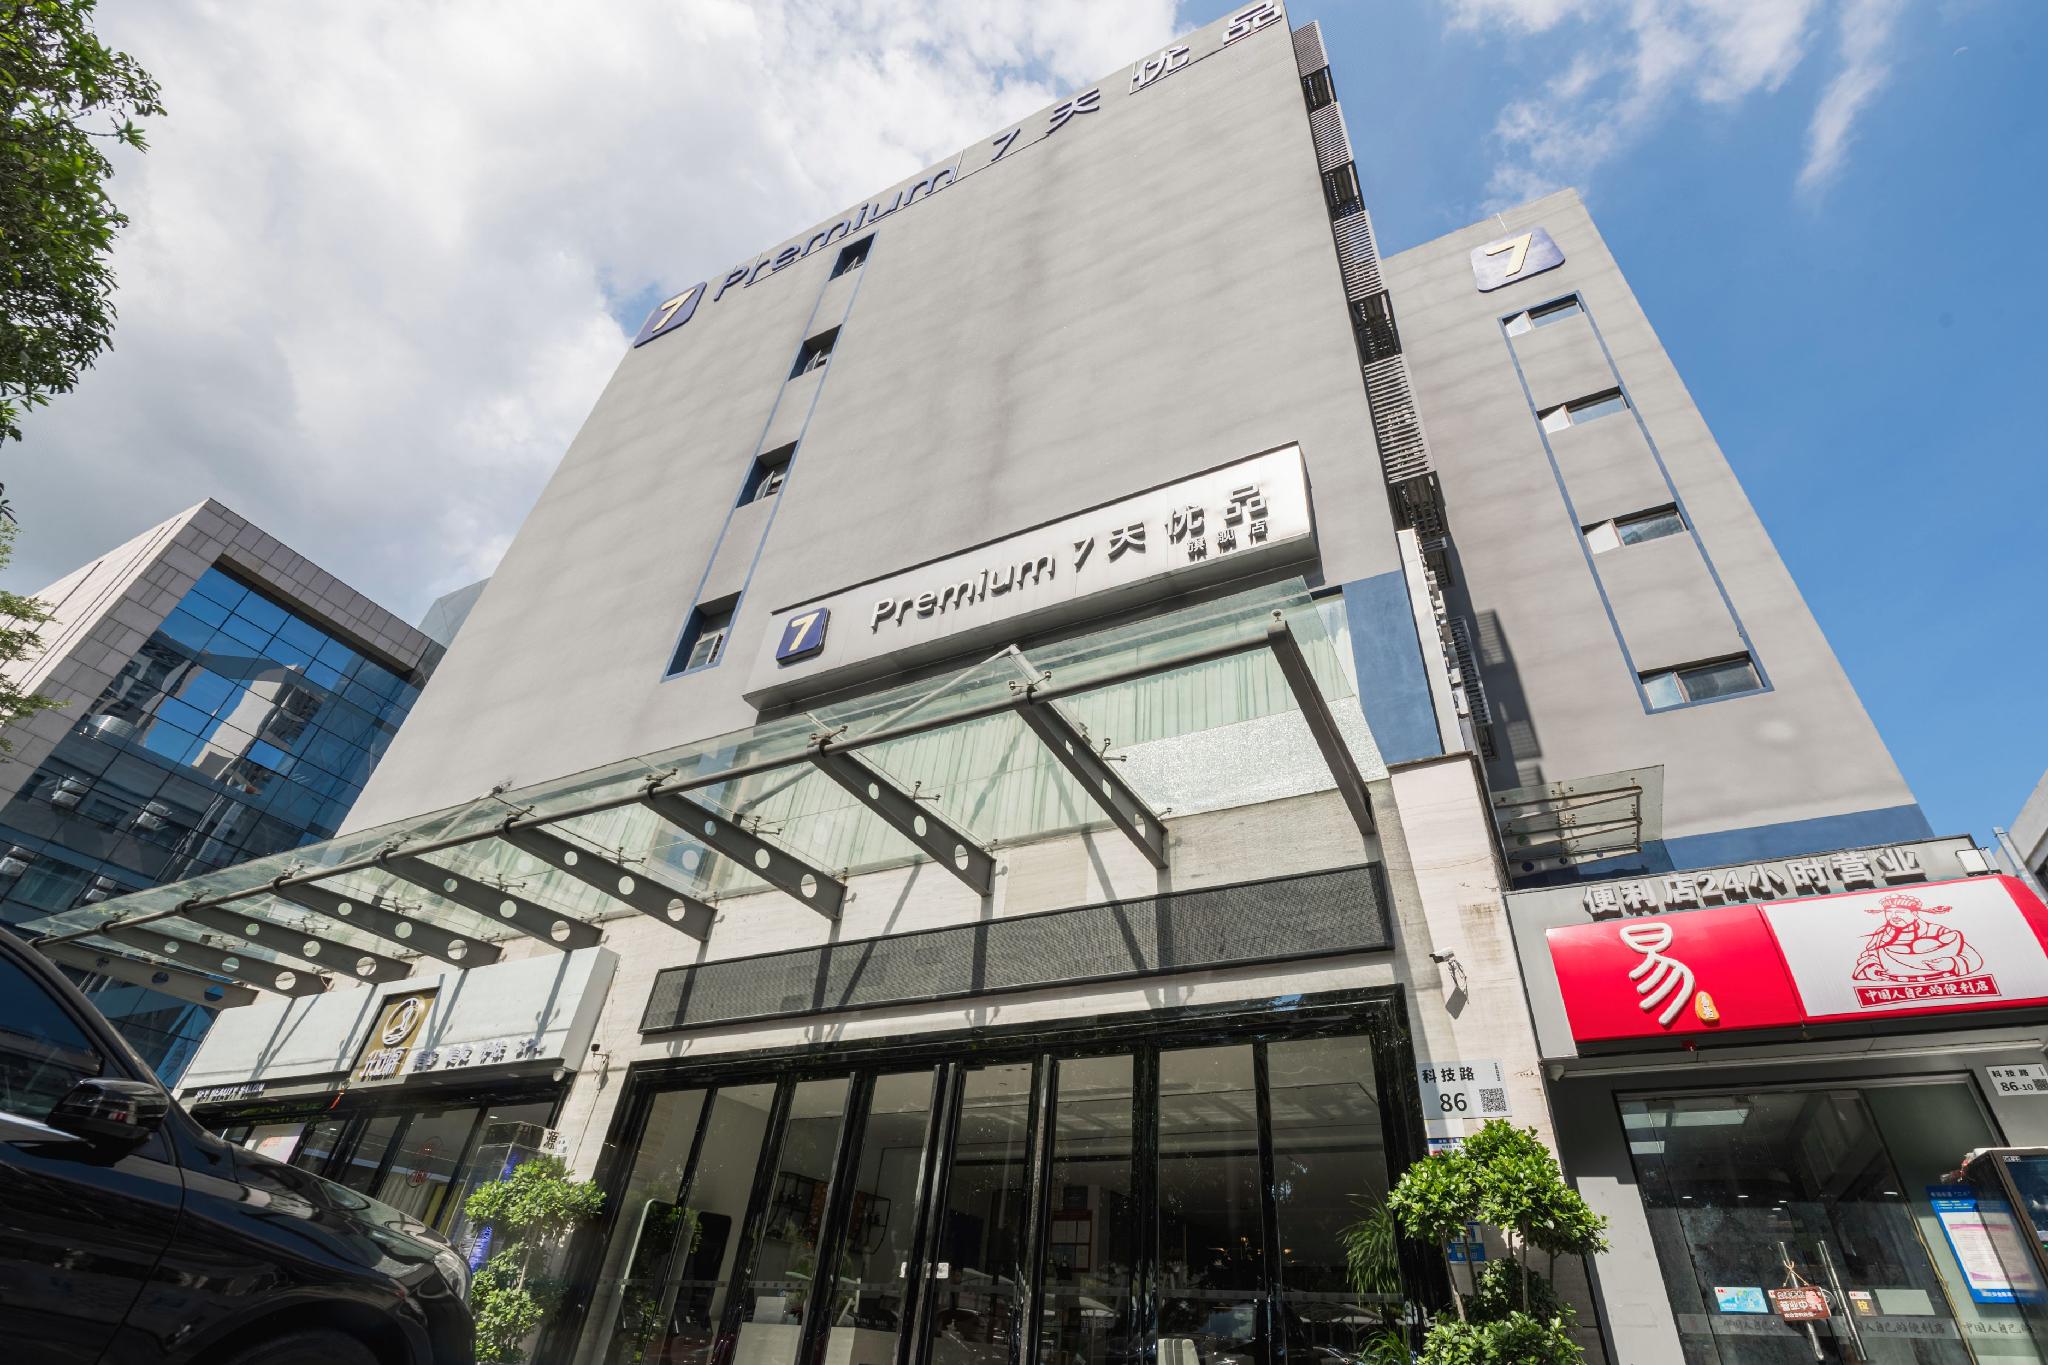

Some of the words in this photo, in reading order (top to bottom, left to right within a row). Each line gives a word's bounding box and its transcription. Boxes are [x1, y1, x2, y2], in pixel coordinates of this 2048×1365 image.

[713, 166, 958, 301] Premium
[789, 612, 822, 651] 7
[870, 553, 1055, 632] Premium
[1583, 847, 1926, 918] 便利店24小时营业
[1865, 980, 1989, 1003] 中国人自己的便利店
[1422, 1067, 1475, 1083] 科技路
[1439, 1092, 1468, 1112] 86
